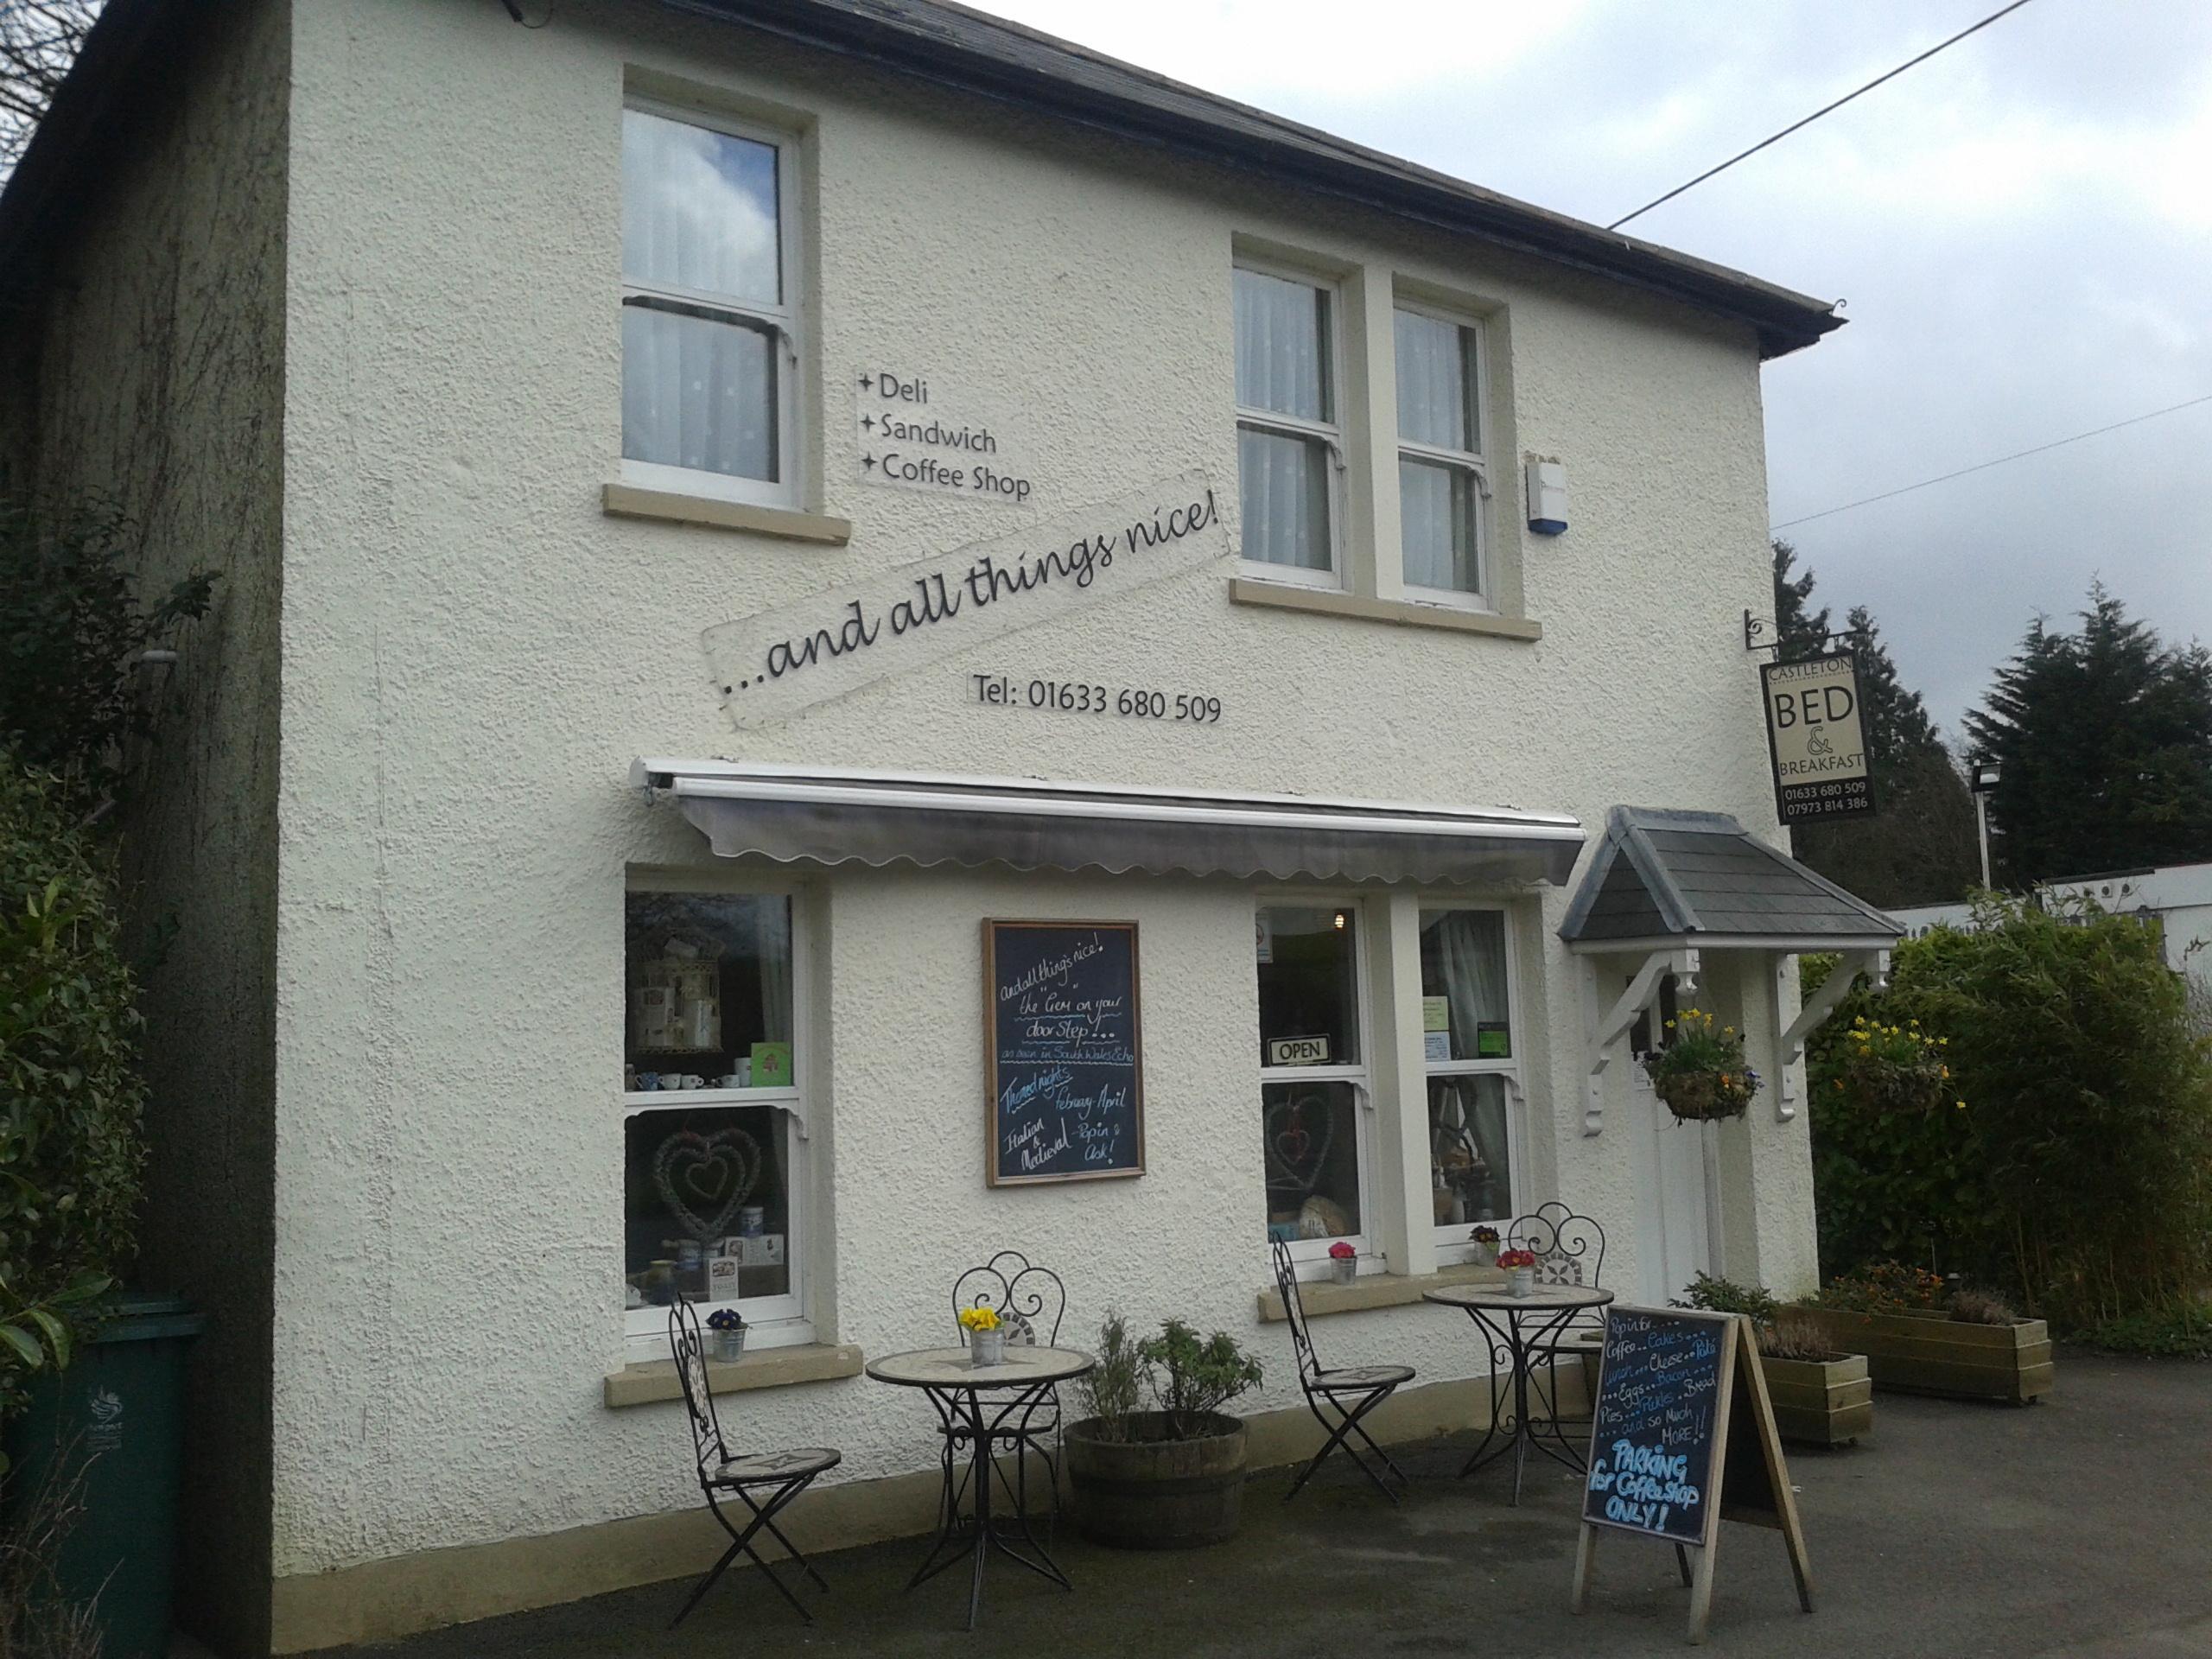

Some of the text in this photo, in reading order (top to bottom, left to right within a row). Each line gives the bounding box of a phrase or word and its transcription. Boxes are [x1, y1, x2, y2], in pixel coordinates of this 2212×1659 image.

[880, 373, 928, 404] Deli
[881, 415, 996, 454] Sandwich
[882, 454, 1031, 501] Coffee Shop
[891, 574, 962, 636] all
[964, 535, 1116, 607] things
[1127, 489, 1219, 553] nice!
[1769, 658, 1853, 681] CASTLETON
[973, 675, 1221, 722] Tel: 01633 680 509
[1774, 686, 1853, 728] BED
[1807, 726, 1834, 755] &
[1779, 753, 1864, 776] BREAKFAST
[1785, 782, 1866, 800] 01633 680 509
[1787, 797, 1868, 816] 07973 814 386
[1074, 931, 1103, 963] nice!
[1020, 993, 1038, 1014] the
[1077, 1001, 1091, 1011] on
[1087, 996, 1122, 1024] your
[1027, 1020, 1054, 1038] door
[1041, 1047, 1051, 1058] in
[1111, 1046, 1135, 1062] Echo
[1279, 1041, 1320, 1060] OPEN
[1003, 1117, 1044, 1154] Italian
[1589, 1459, 1615, 1491] for
[1605, 1495, 1669, 1532] ONLY!
